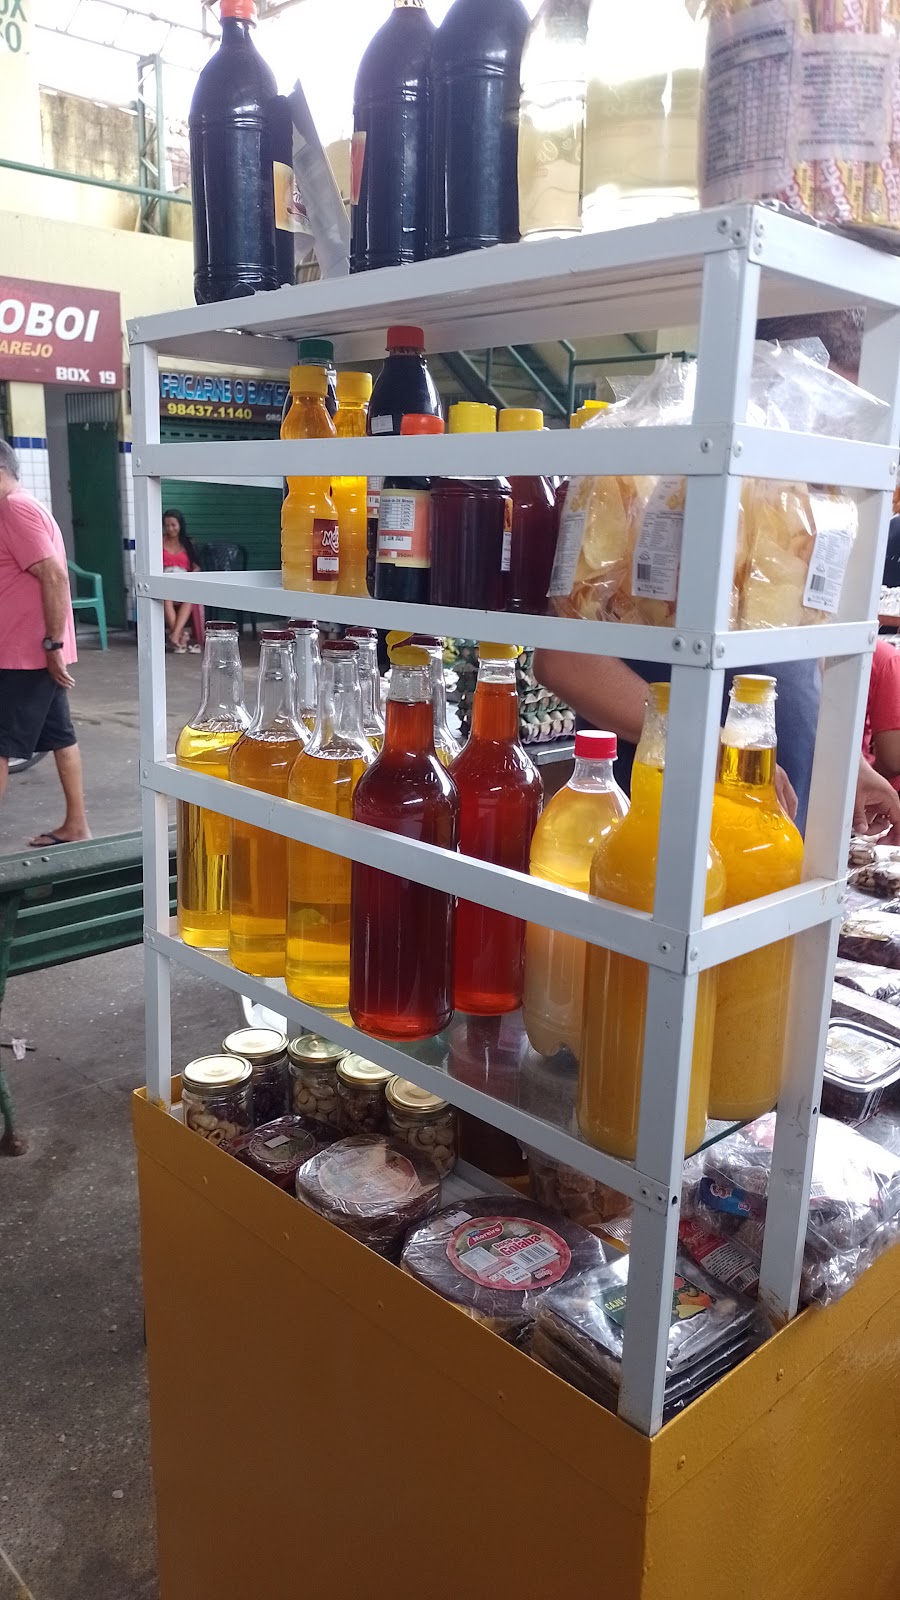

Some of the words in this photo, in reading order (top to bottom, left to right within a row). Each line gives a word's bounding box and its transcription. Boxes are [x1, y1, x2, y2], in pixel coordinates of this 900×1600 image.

[56, 366, 90, 382] BOX
[98, 370, 116, 385] 19
[161, 372, 232, 403] FRICARNE
[234, 379, 246, 404] O
[167, 402, 252, 420] 98437.1140
[472, 1226, 500, 1242] Moreira
[494, 1239, 513, 1249] Doce
[500, 1235, 542, 1256] Goiaba
